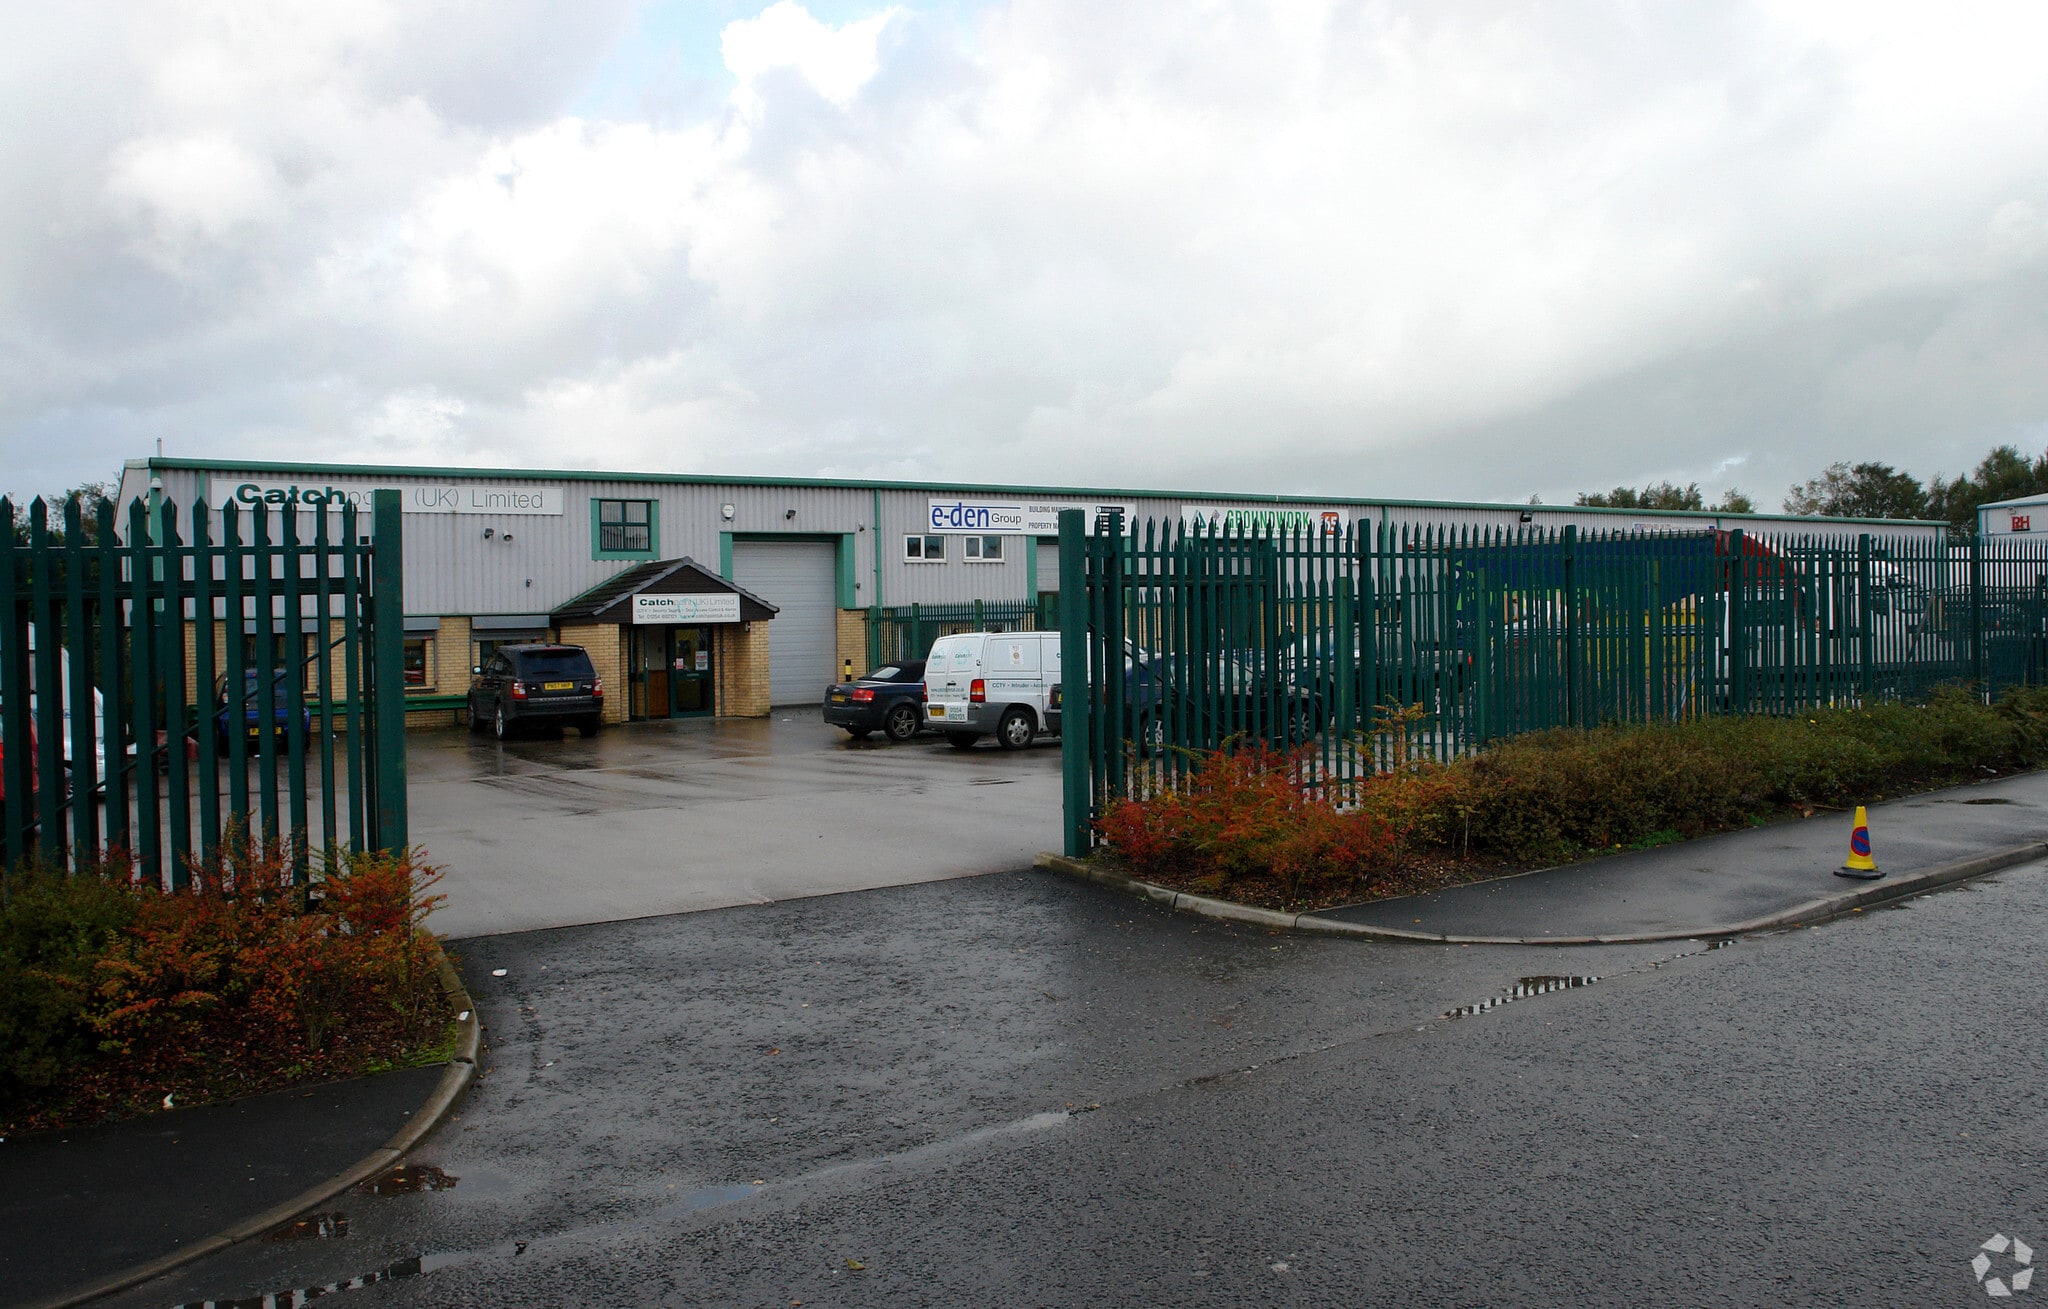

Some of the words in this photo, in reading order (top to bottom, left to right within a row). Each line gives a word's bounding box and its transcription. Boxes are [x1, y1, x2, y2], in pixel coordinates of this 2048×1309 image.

[414, 487, 459, 508] (UK)
[471, 489, 543, 509] Limited
[1029, 505, 1051, 513] BUILDING
[931, 502, 990, 528] e-den
[991, 513, 1022, 525] Group
